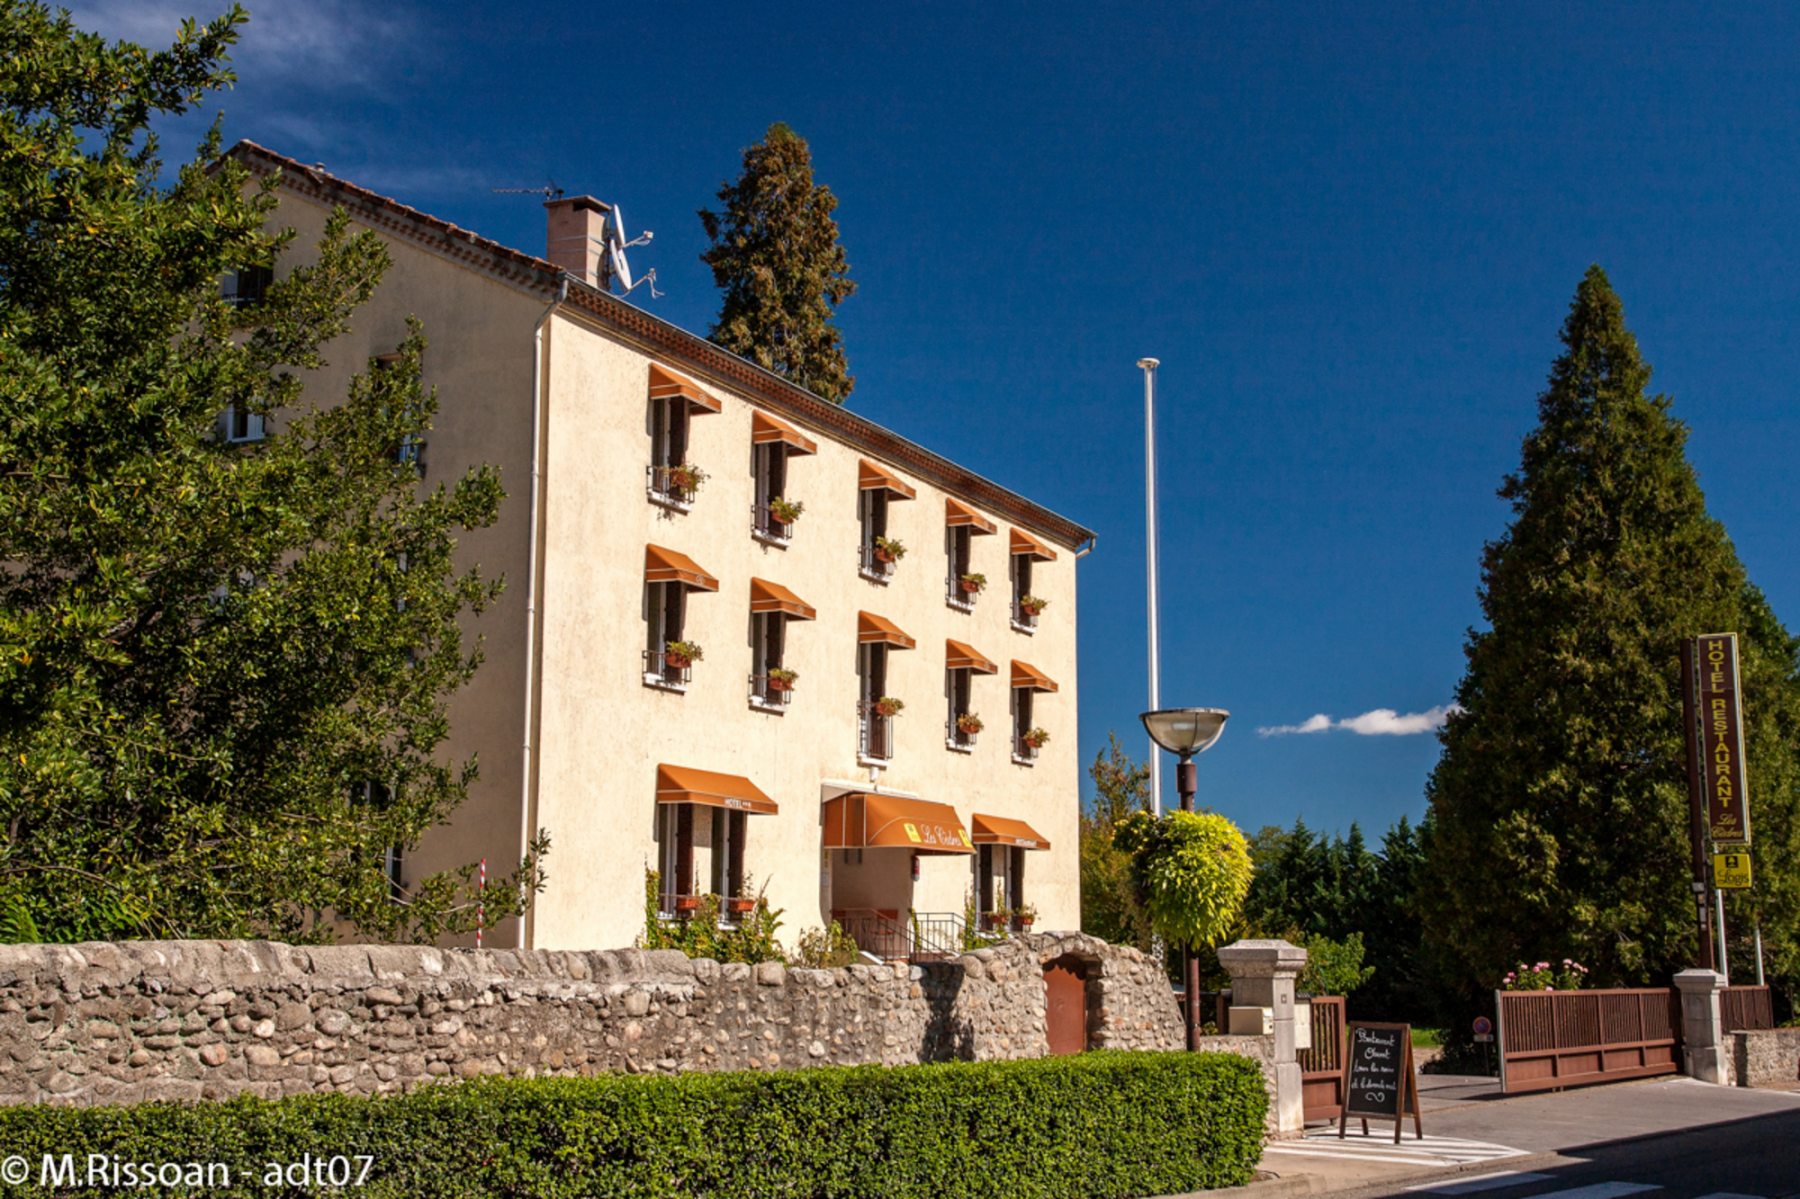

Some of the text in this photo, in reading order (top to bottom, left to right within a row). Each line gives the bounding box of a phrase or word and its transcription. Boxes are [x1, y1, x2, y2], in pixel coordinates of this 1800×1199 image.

[1707, 640, 1725, 693] HOTEL
[1711, 698, 1733, 809] RESTAURANT
[1717, 869, 1750, 886] Logis
